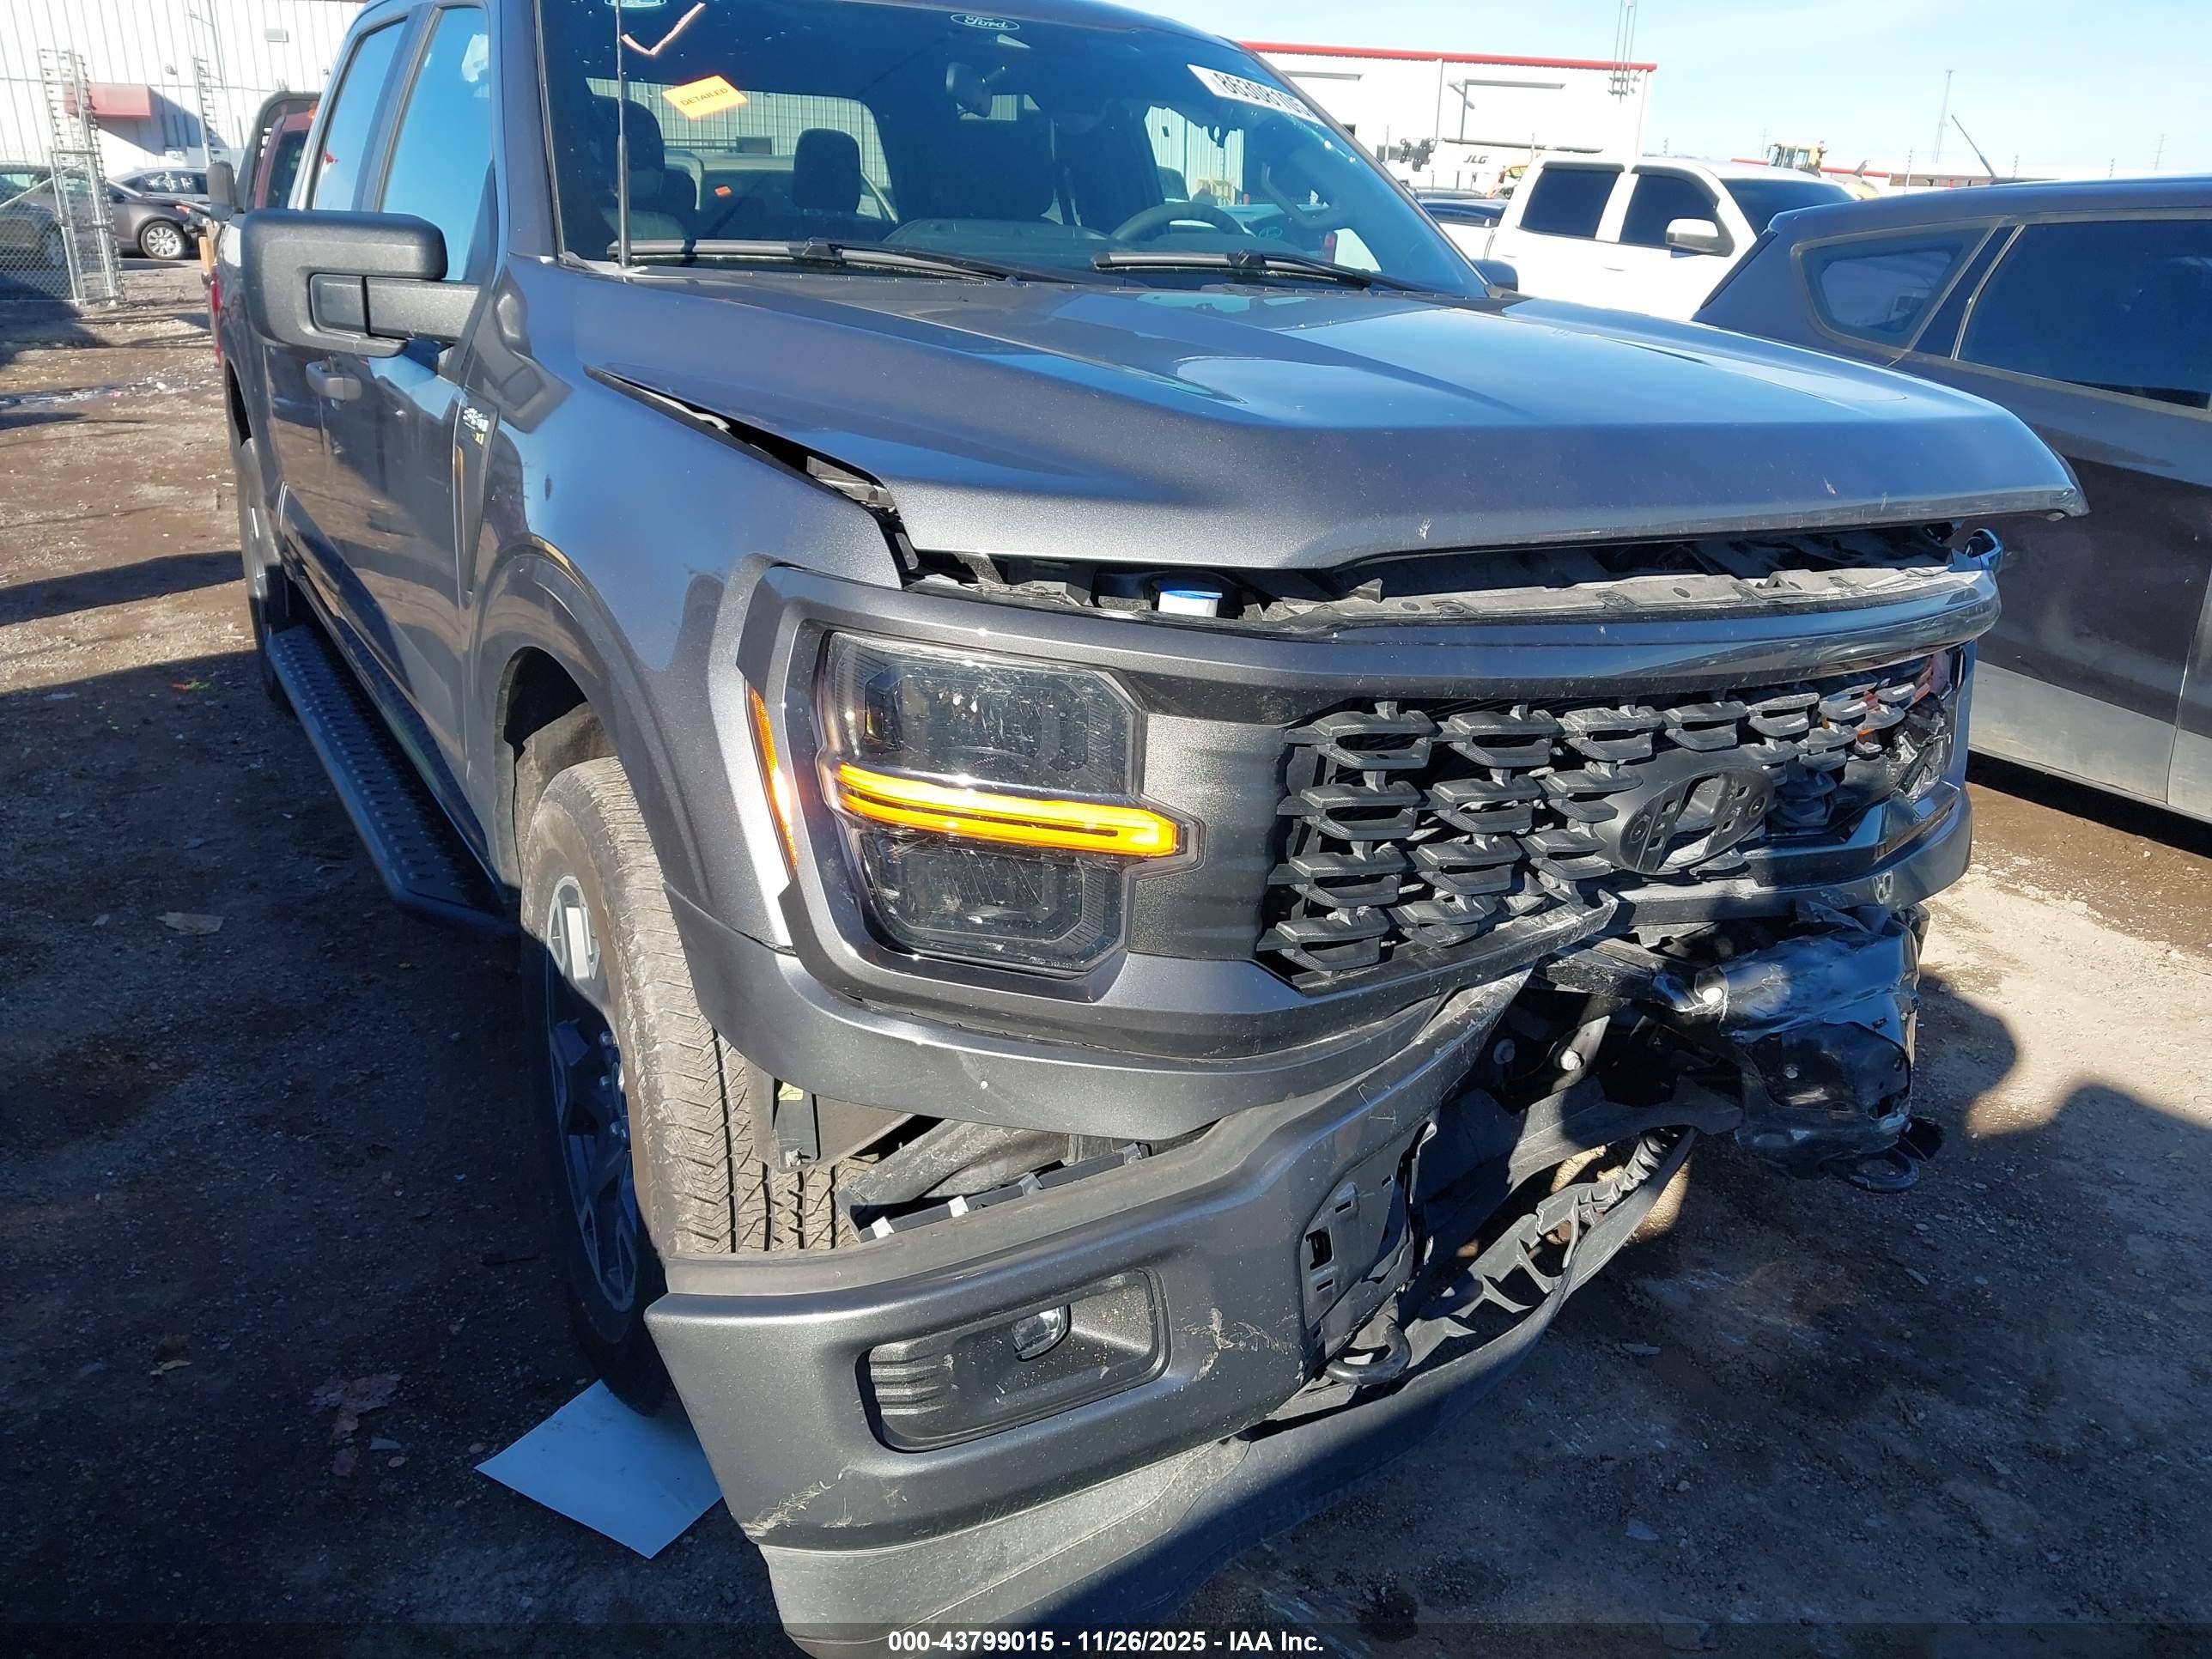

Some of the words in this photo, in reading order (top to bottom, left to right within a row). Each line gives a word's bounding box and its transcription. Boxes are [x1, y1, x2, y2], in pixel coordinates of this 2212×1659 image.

[963, 14, 1009, 29] Ford
[680, 88, 728, 106] DETAILED
[1463, 155, 1489, 164] JLG
